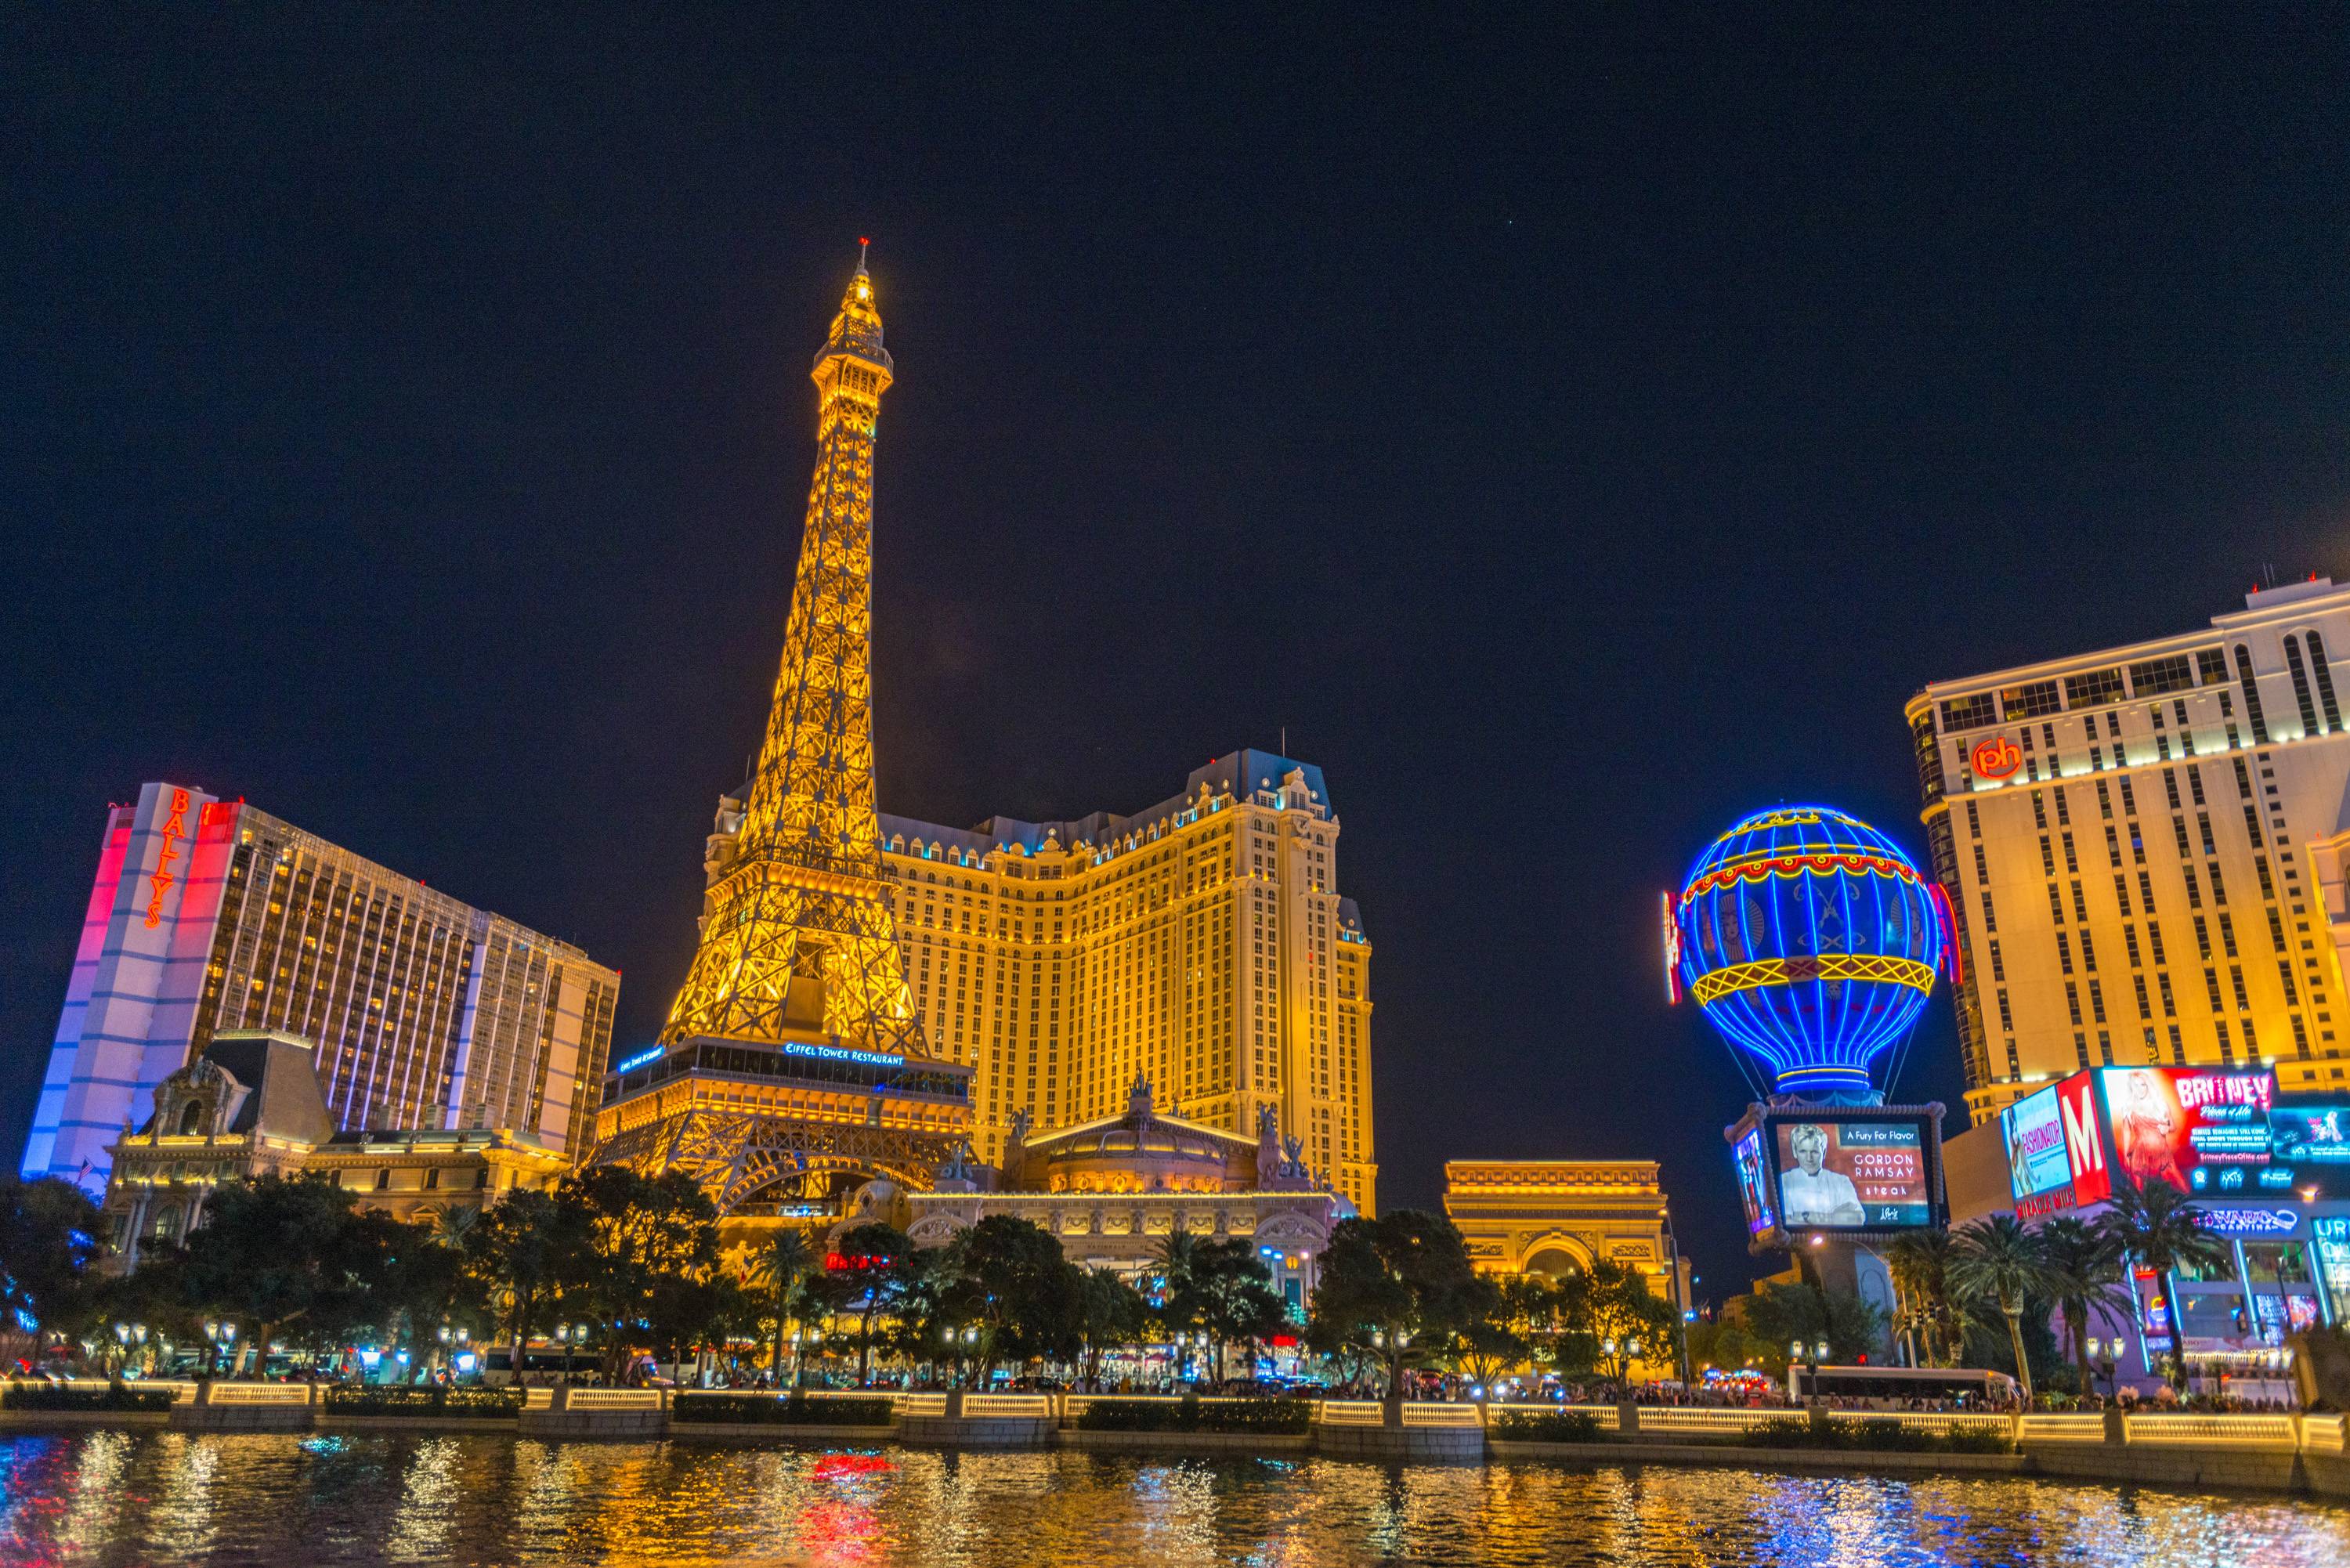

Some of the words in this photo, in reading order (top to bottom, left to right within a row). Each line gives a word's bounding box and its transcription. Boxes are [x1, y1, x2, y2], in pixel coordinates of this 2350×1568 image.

[1977, 736, 2021, 775] ph
[144, 789, 190, 930] BALLYS
[786, 1042, 815, 1056] EIFFEL
[818, 1046, 848, 1060] TOWER
[851, 1051, 903, 1066] RESTAURANT
[2176, 1075, 2271, 1112] BRITNEY
[1847, 1131, 1854, 1140] A
[1856, 1131, 1872, 1141] Fury
[1875, 1131, 1887, 1140] For
[1889, 1130, 1914, 1140] Flavor
[2022, 1120, 2062, 1156] FASHIONATOR
[2062, 1085, 2103, 1178] M
[1854, 1154, 1913, 1165] GORDON
[1855, 1167, 1914, 1177] RAMSAY
[1866, 1186, 1907, 1195] steak
[2016, 1193, 2052, 1220] MIRACLE
[2053, 1187, 2074, 1210] MILE
[2316, 1219, 2350, 1235] UR
